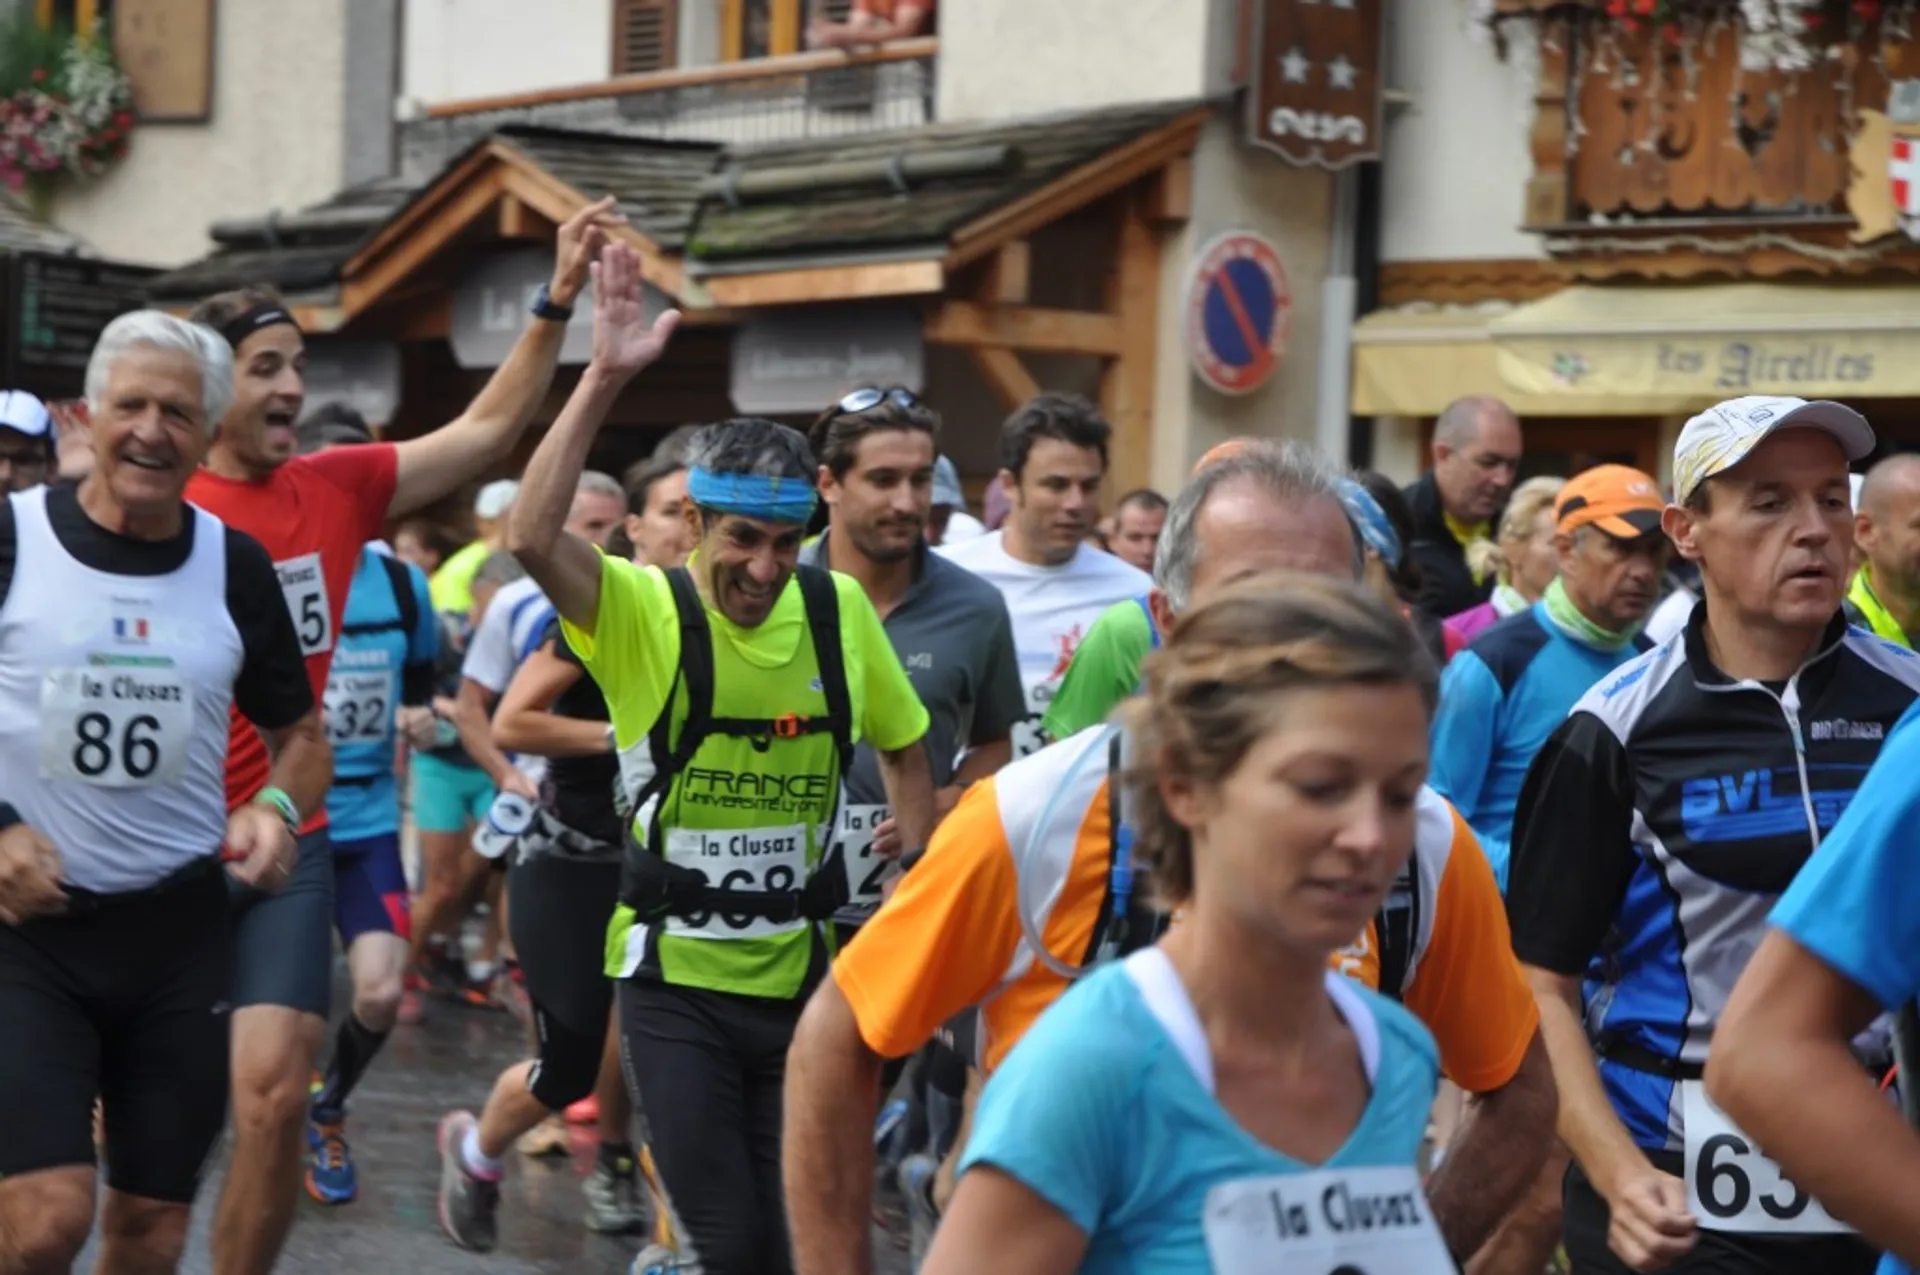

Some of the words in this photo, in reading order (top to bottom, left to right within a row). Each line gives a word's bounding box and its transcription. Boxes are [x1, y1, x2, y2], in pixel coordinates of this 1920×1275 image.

[300, 592, 326, 647] 5
[81, 673, 105, 699] la
[112, 675, 183, 703] Clusaz
[72, 711, 161, 780] 86
[686, 767, 829, 798] FRANCE
[844, 810, 863, 830] la
[701, 834, 720, 857] la
[729, 835, 796, 858] Clusaz
[1695, 1133, 1845, 1222] 63
[1269, 1186, 1309, 1240] la
[1320, 1180, 1421, 1233] Clusaz
